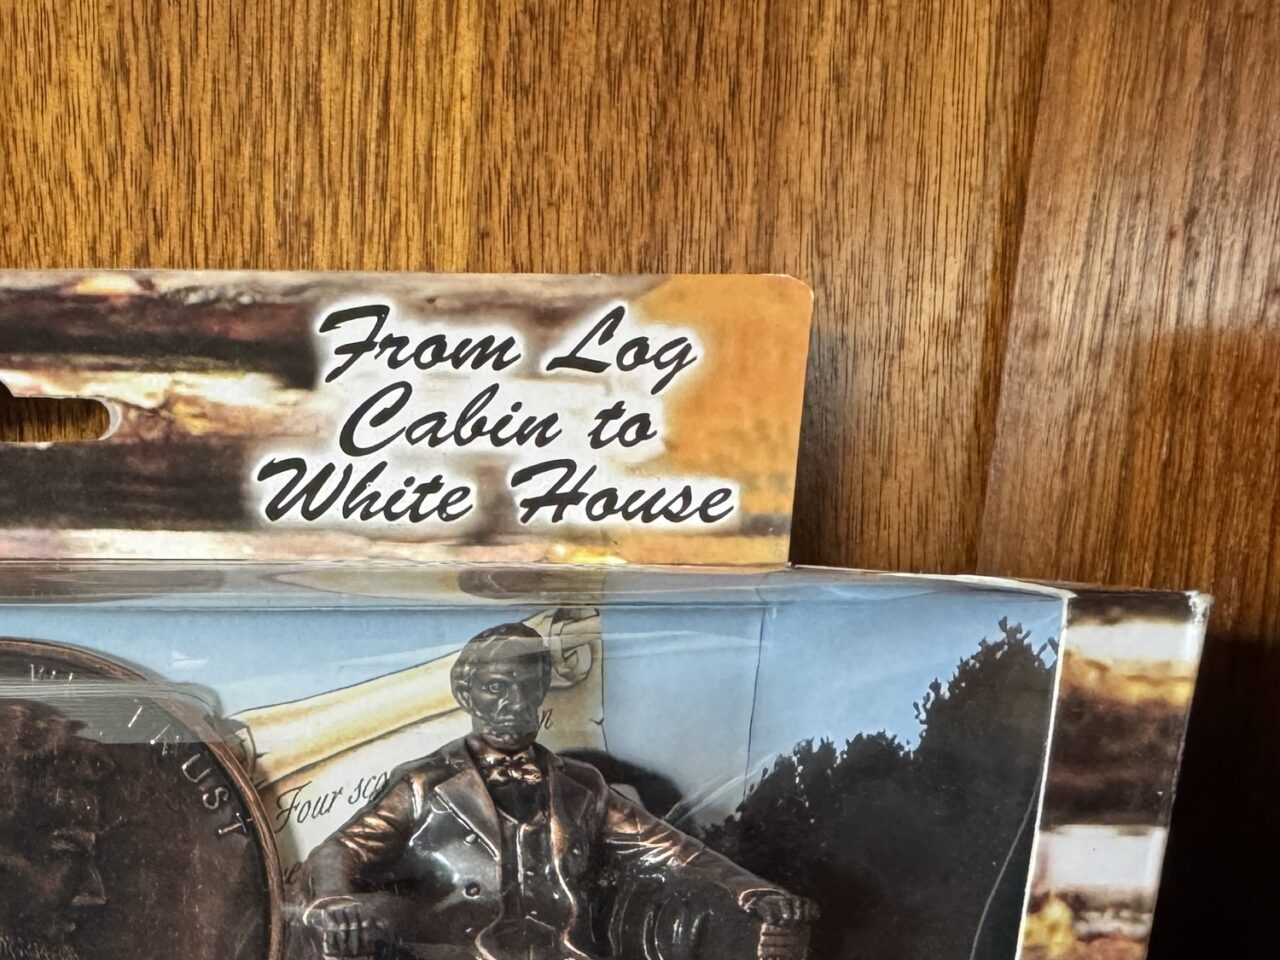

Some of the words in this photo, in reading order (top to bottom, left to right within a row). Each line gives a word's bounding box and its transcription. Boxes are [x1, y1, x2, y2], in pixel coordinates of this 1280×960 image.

[319, 304, 522, 383] From
[546, 305, 697, 395] Log
[339, 380, 562, 457] Cabin
[587, 400, 658, 450] to
[256, 457, 475, 523] White
[510, 458, 735, 524] House
[274, 780, 344, 834] Four
[348, 771, 390, 805] sco
